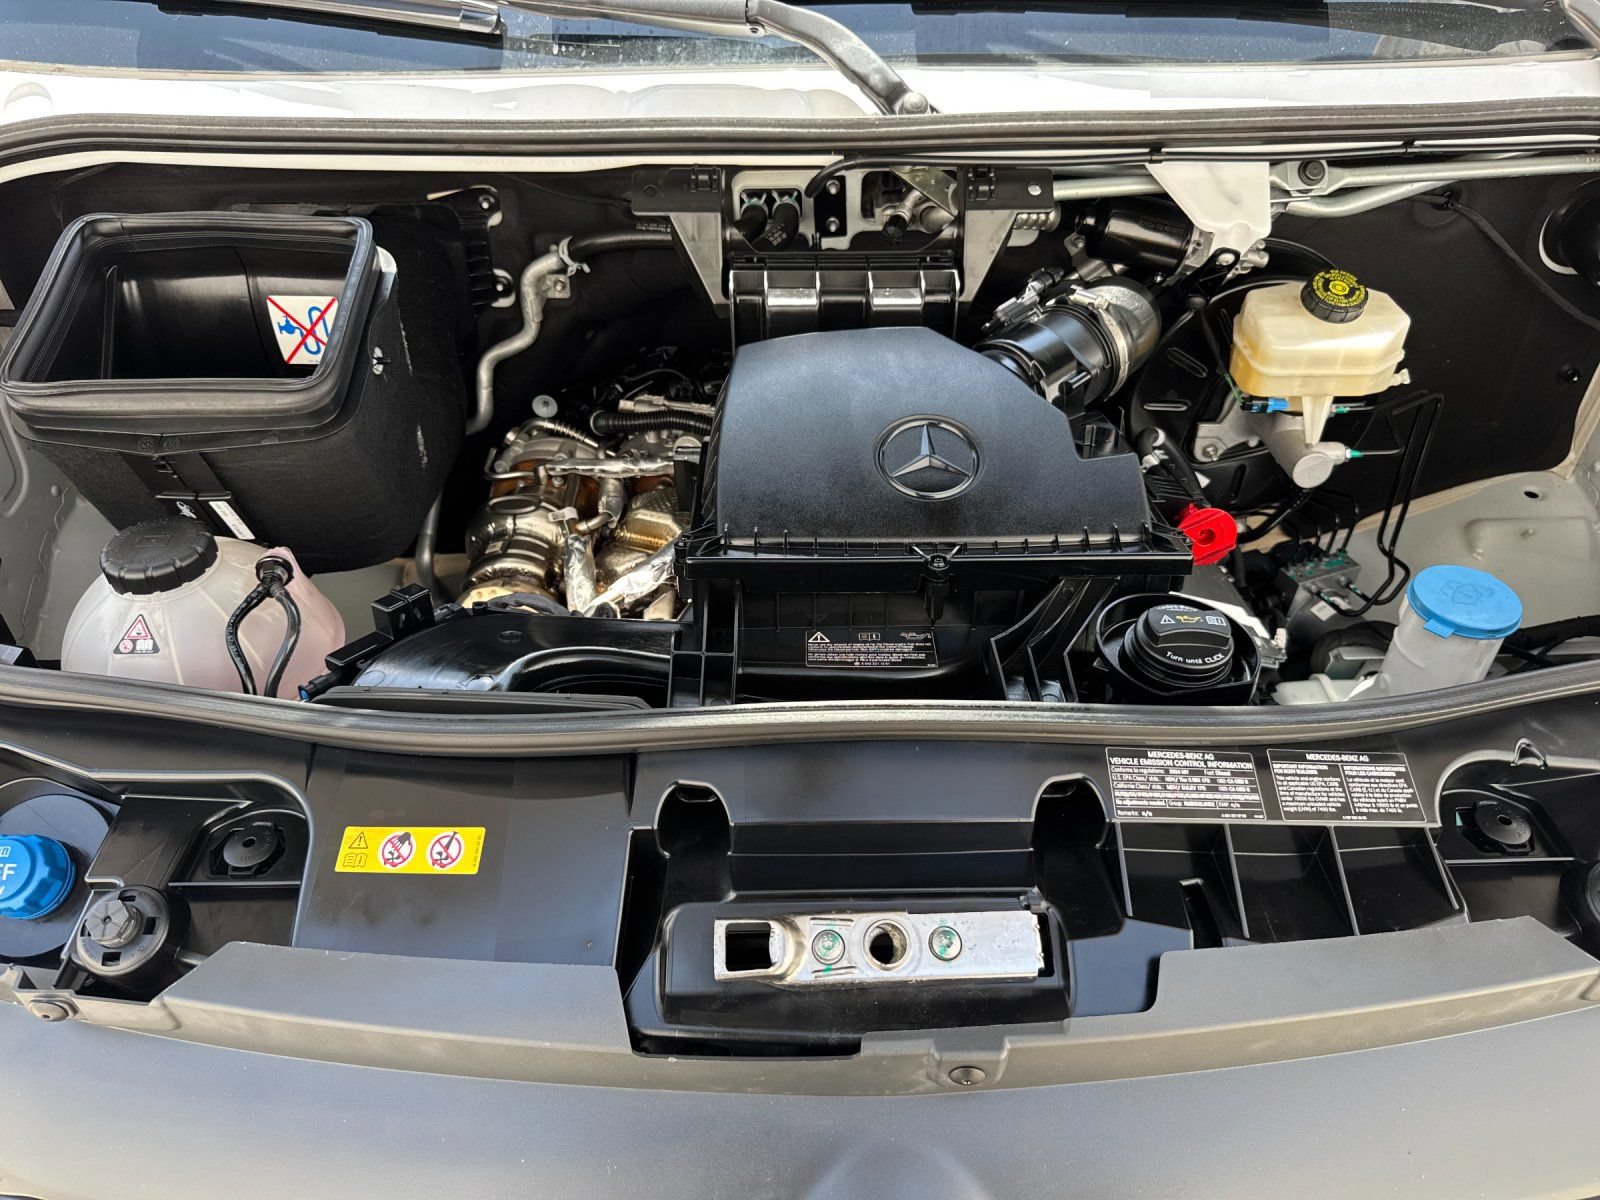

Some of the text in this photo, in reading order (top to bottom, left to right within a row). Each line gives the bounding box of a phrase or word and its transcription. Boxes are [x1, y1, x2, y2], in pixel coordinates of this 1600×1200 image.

[1166, 651, 1183, 662] Turn
[1204, 653, 1225, 664] CLICK
[1147, 750, 1203, 760] MERCEDES-BENZ
[1305, 753, 1358, 762] MERCEDES-BENZ
[1109, 757, 1253, 769] VEHICLE EMISSION CONTROL INFORMATION
